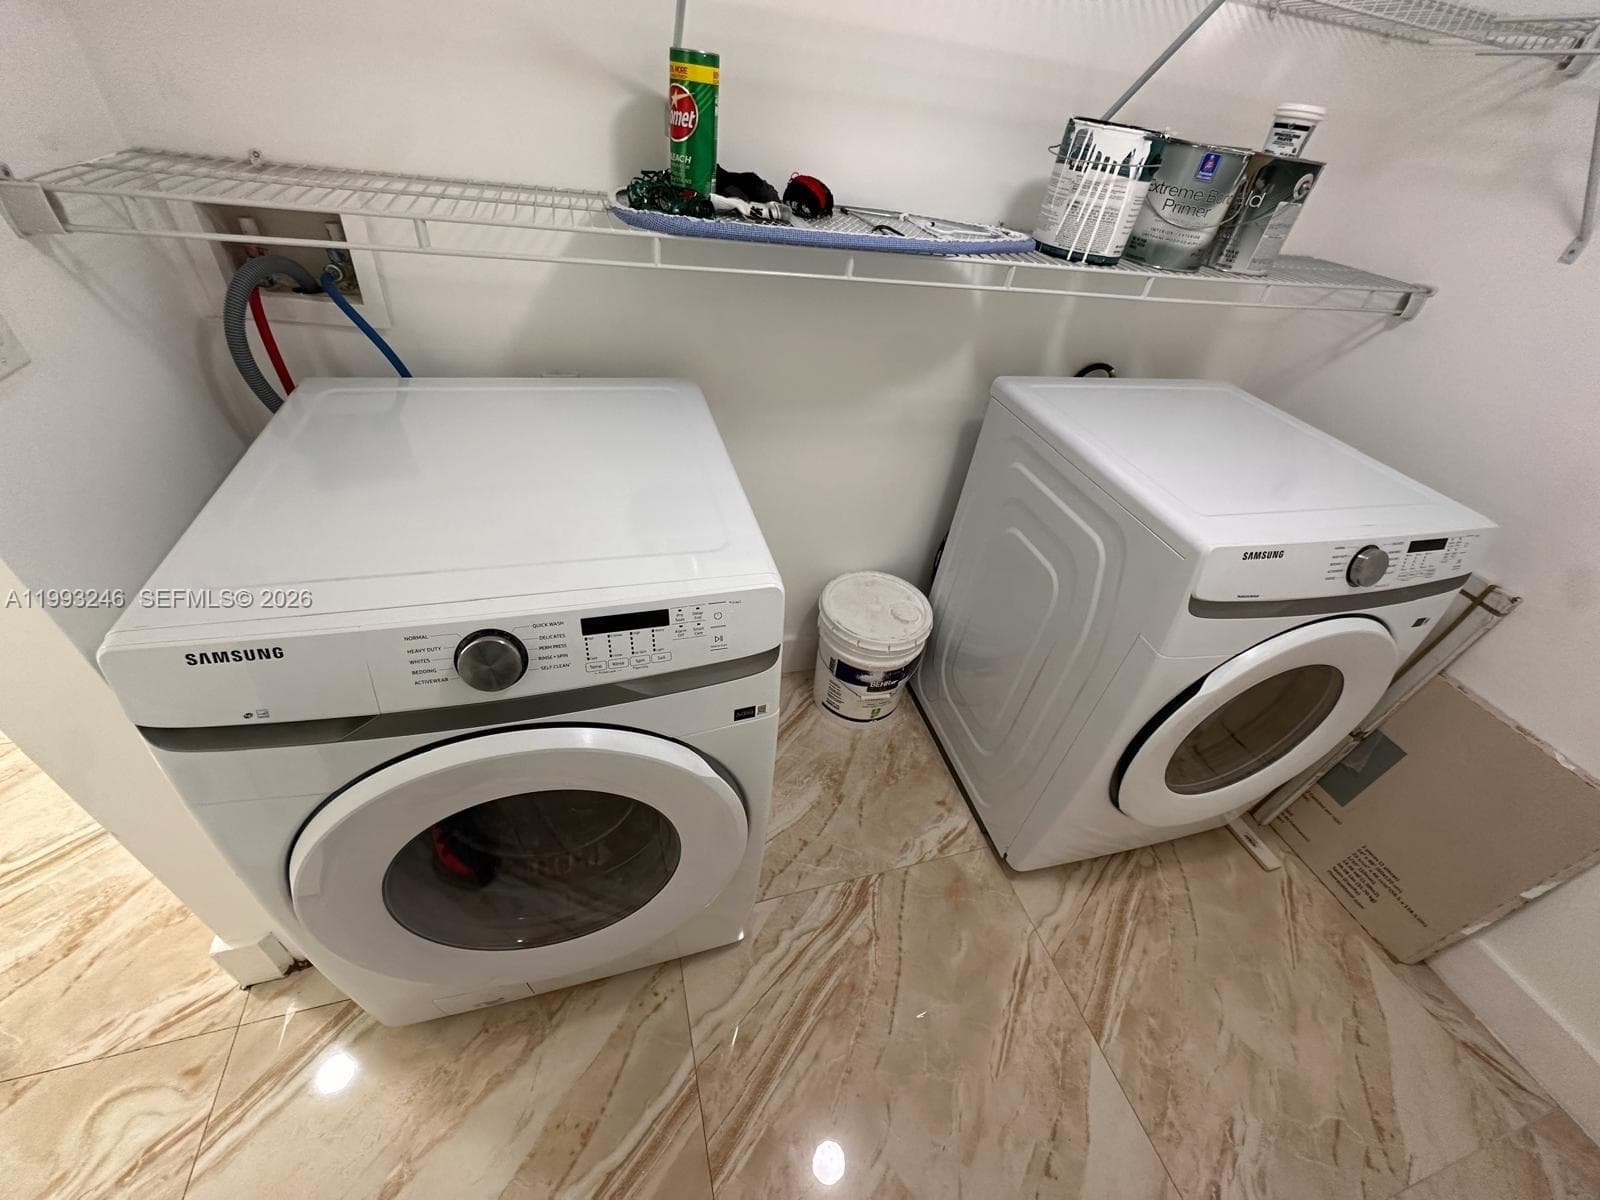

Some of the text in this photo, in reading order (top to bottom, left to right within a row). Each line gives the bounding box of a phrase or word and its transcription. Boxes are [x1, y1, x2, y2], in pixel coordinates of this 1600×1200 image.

[1161, 198, 1213, 219] Primer
[1242, 550, 1284, 560] SAMSUNG
[184, 646, 285, 666] SAMSUNG
[414, 677, 449, 685] ACTIVEWEAR
